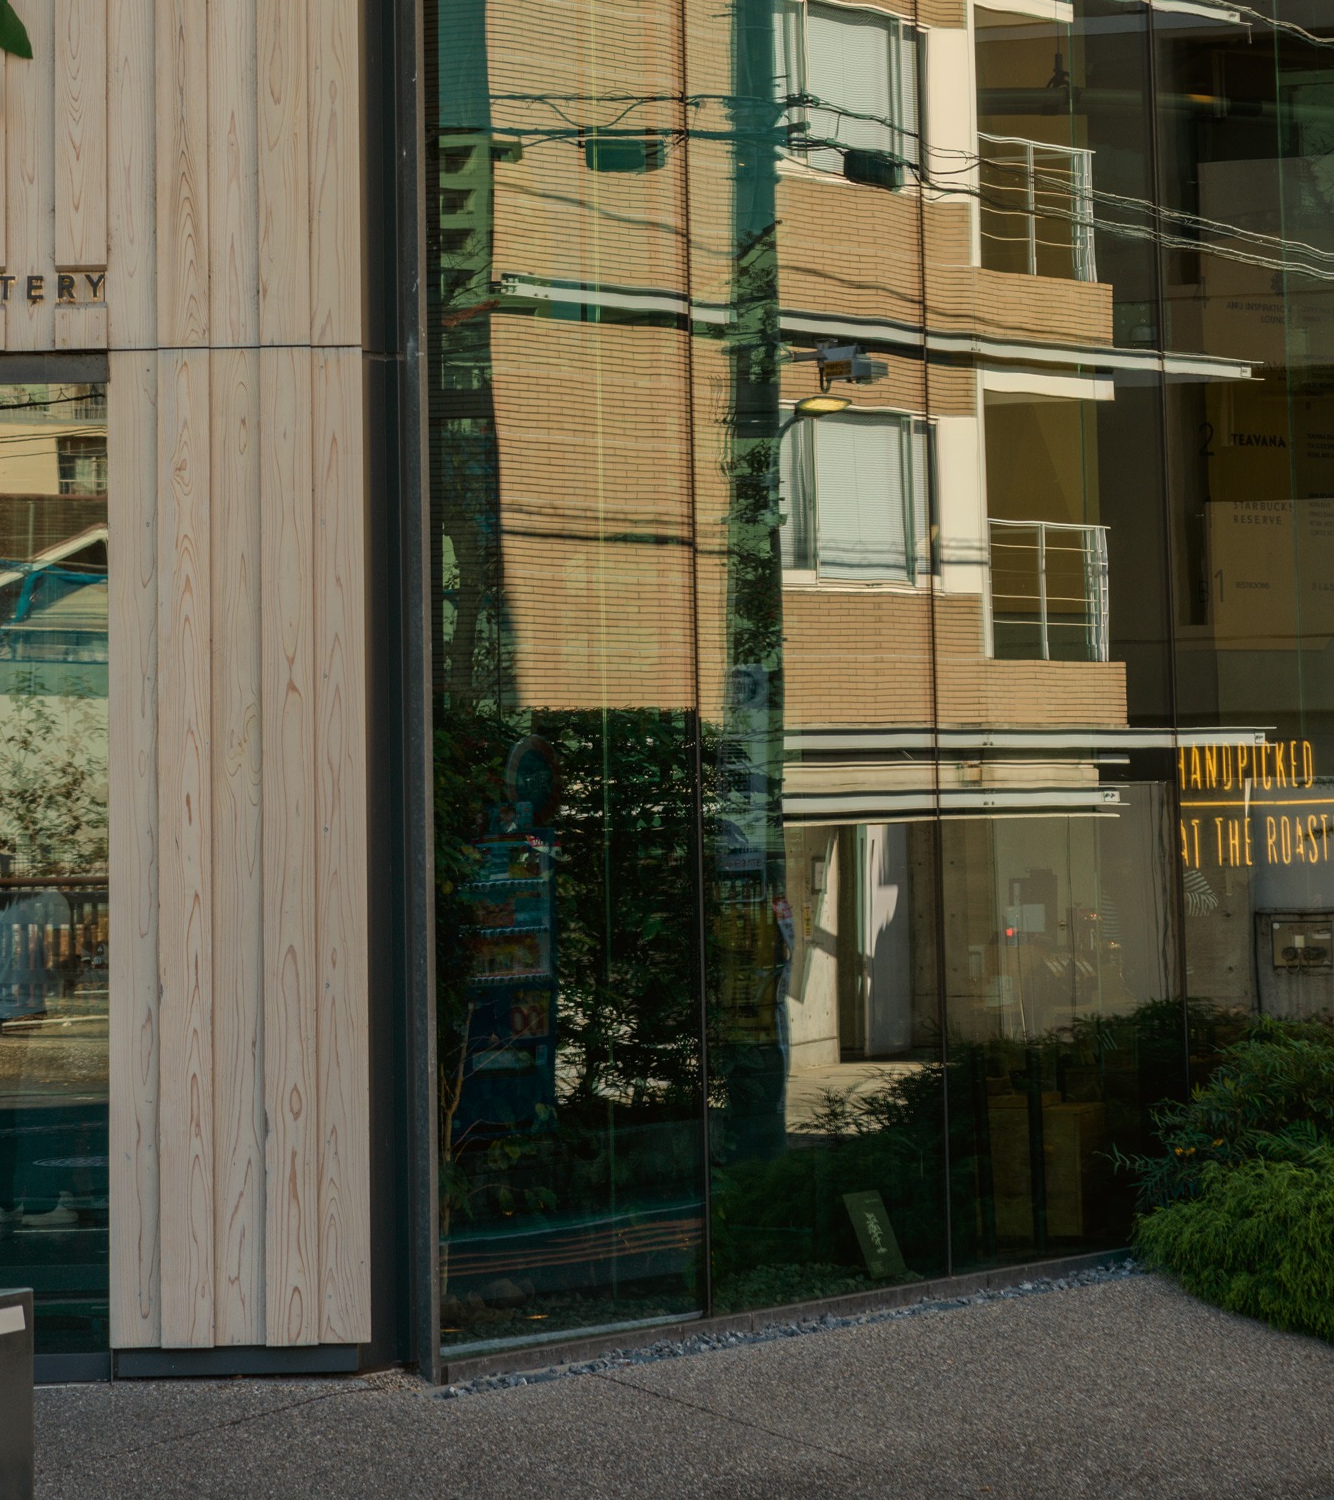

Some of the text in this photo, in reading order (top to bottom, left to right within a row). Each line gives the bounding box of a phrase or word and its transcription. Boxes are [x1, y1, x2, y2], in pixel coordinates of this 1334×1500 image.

[1231, 433, 1287, 448] TEAVANA
[1233, 514, 1283, 525] RESERVE
[1216, 816, 1253, 867] THE
